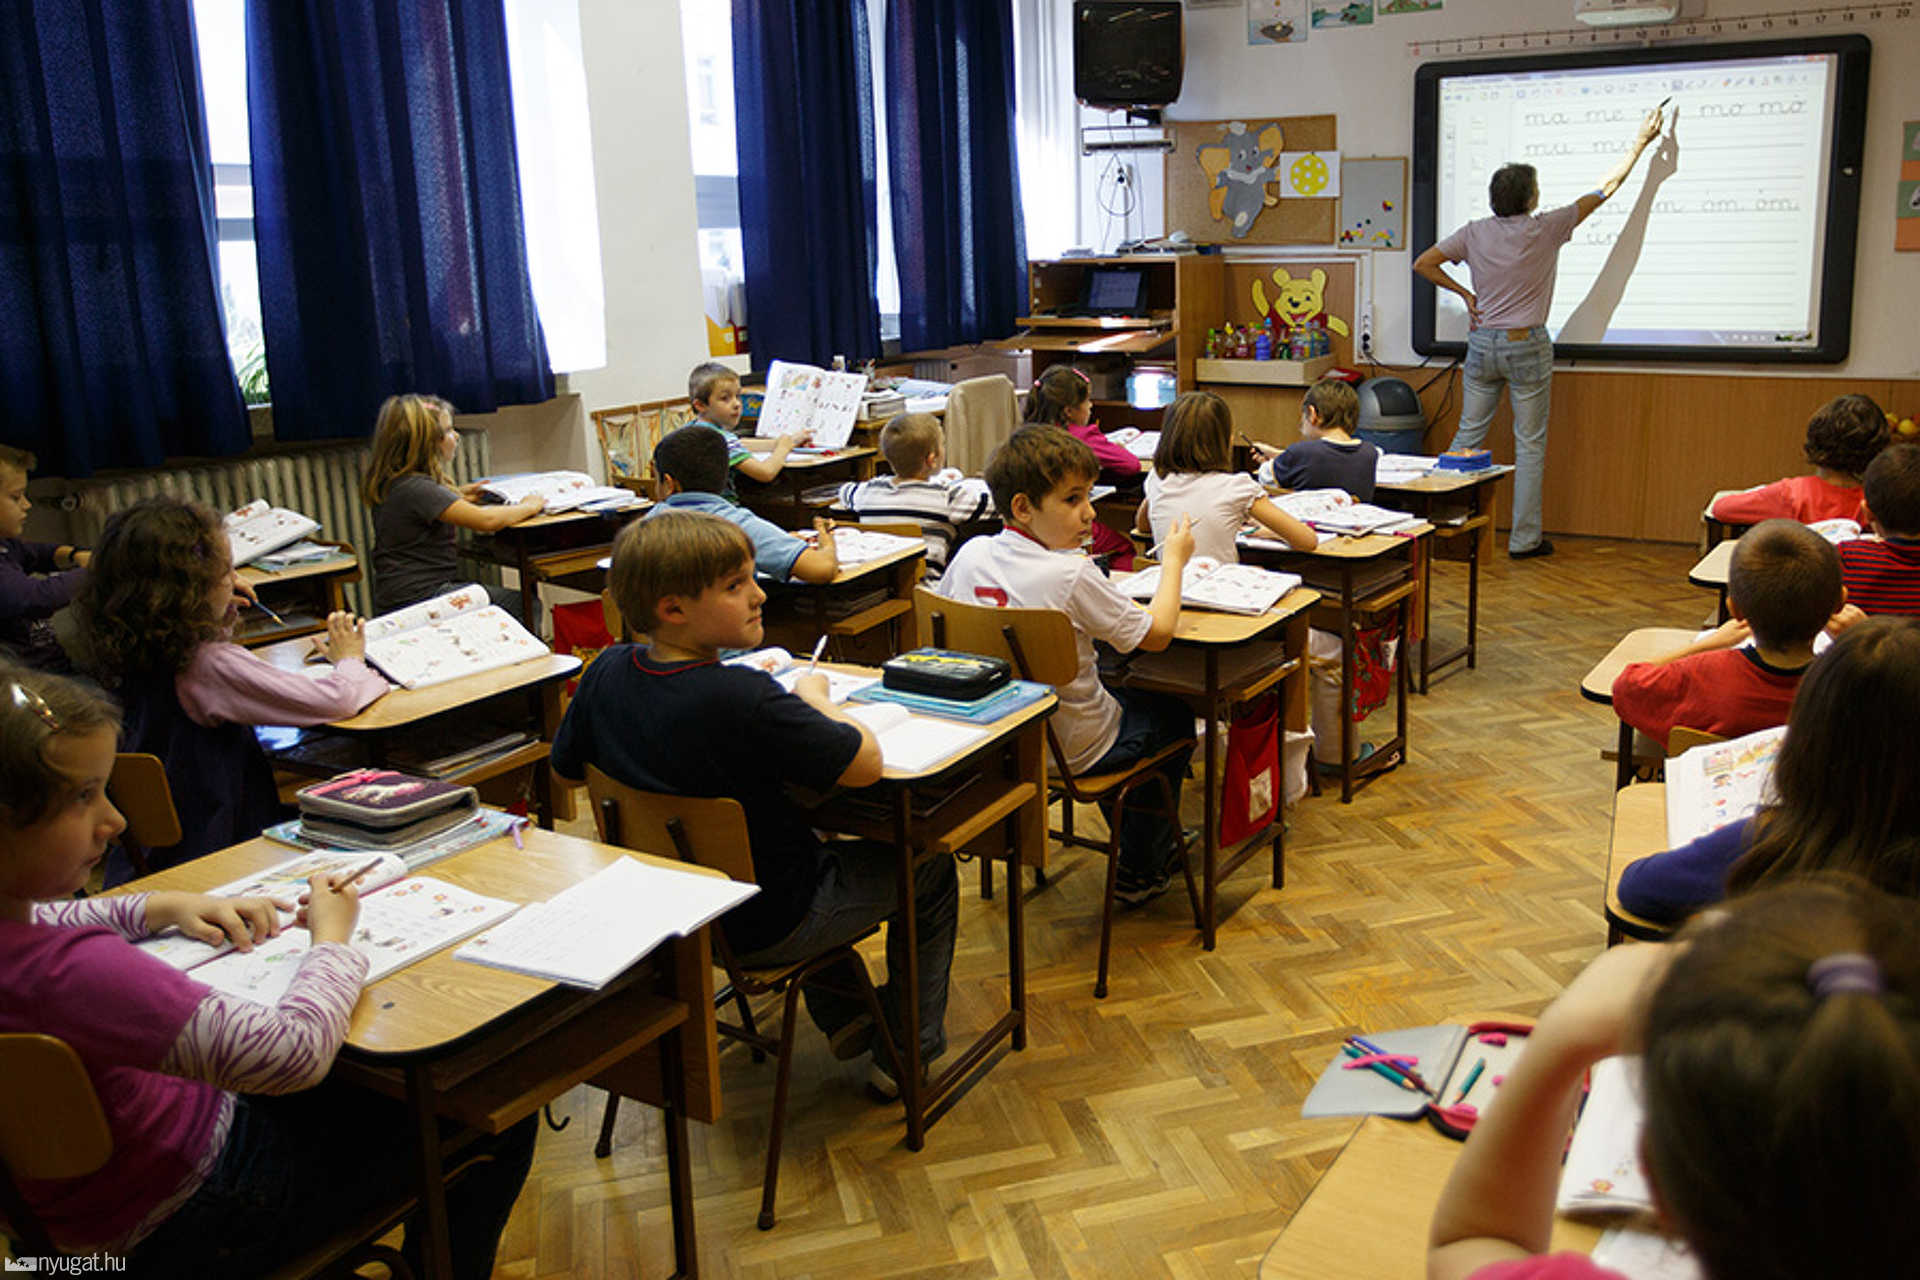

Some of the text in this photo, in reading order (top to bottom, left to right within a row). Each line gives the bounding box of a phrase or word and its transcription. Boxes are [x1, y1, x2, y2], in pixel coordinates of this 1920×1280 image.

[1686, 27, 1697, 35] 12
[1762, 20, 1773, 28] 15
[1788, 18, 1798, 26] 16
[1816, 15, 1826, 24] 17
[1843, 13, 1854, 21] 18
[1870, 11, 1881, 19] 19
[1896, 8, 1910, 19] 20
[1525, 112, 1569, 126] ma
